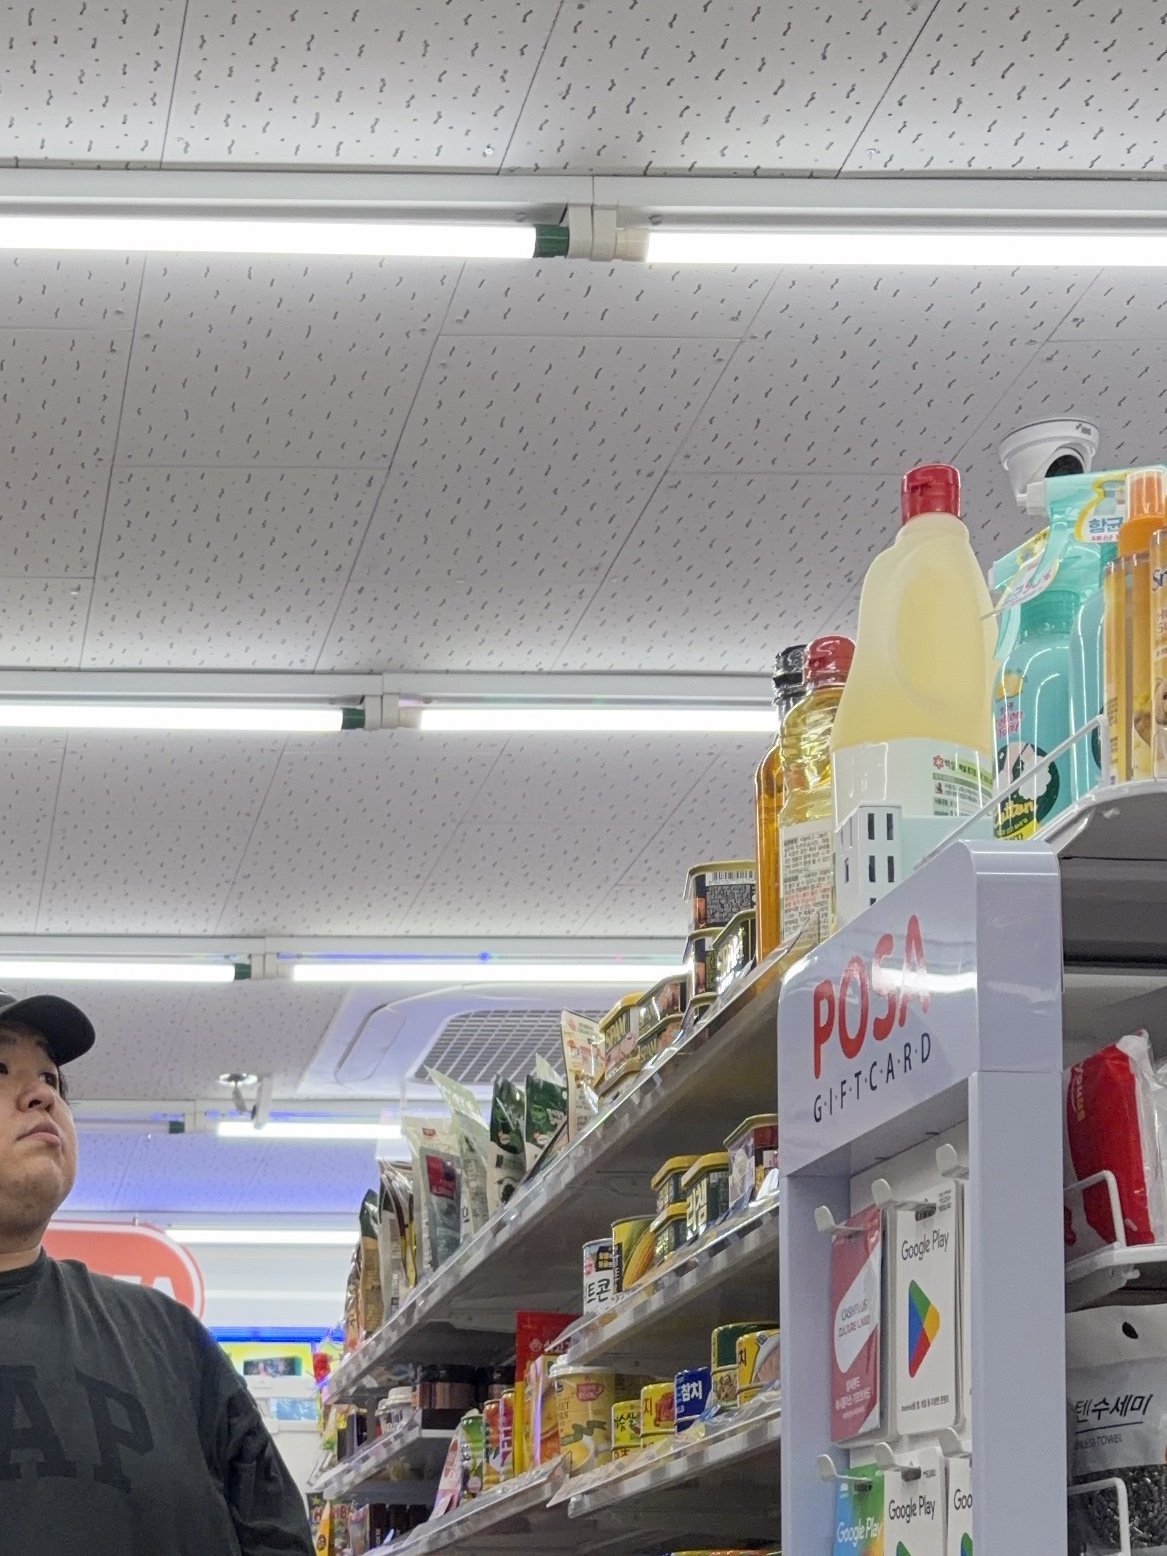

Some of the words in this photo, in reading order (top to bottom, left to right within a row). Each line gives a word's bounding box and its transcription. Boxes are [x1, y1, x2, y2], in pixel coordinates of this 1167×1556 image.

[811, 914, 931, 1079] POSA
[901, 1235, 931, 1261] Google
[932, 1229, 950, 1253] Play
[680, 1381, 703, 1402] 참치
[1074, 1394, 1152, 1422] 텐수세미
[889, 1497, 918, 1523] Google
[919, 1495, 936, 1520] Play
[953, 1489, 973, 1511] Goo
[837, 1521, 865, 1547] Google
[865, 1516, 883, 1541] Play
